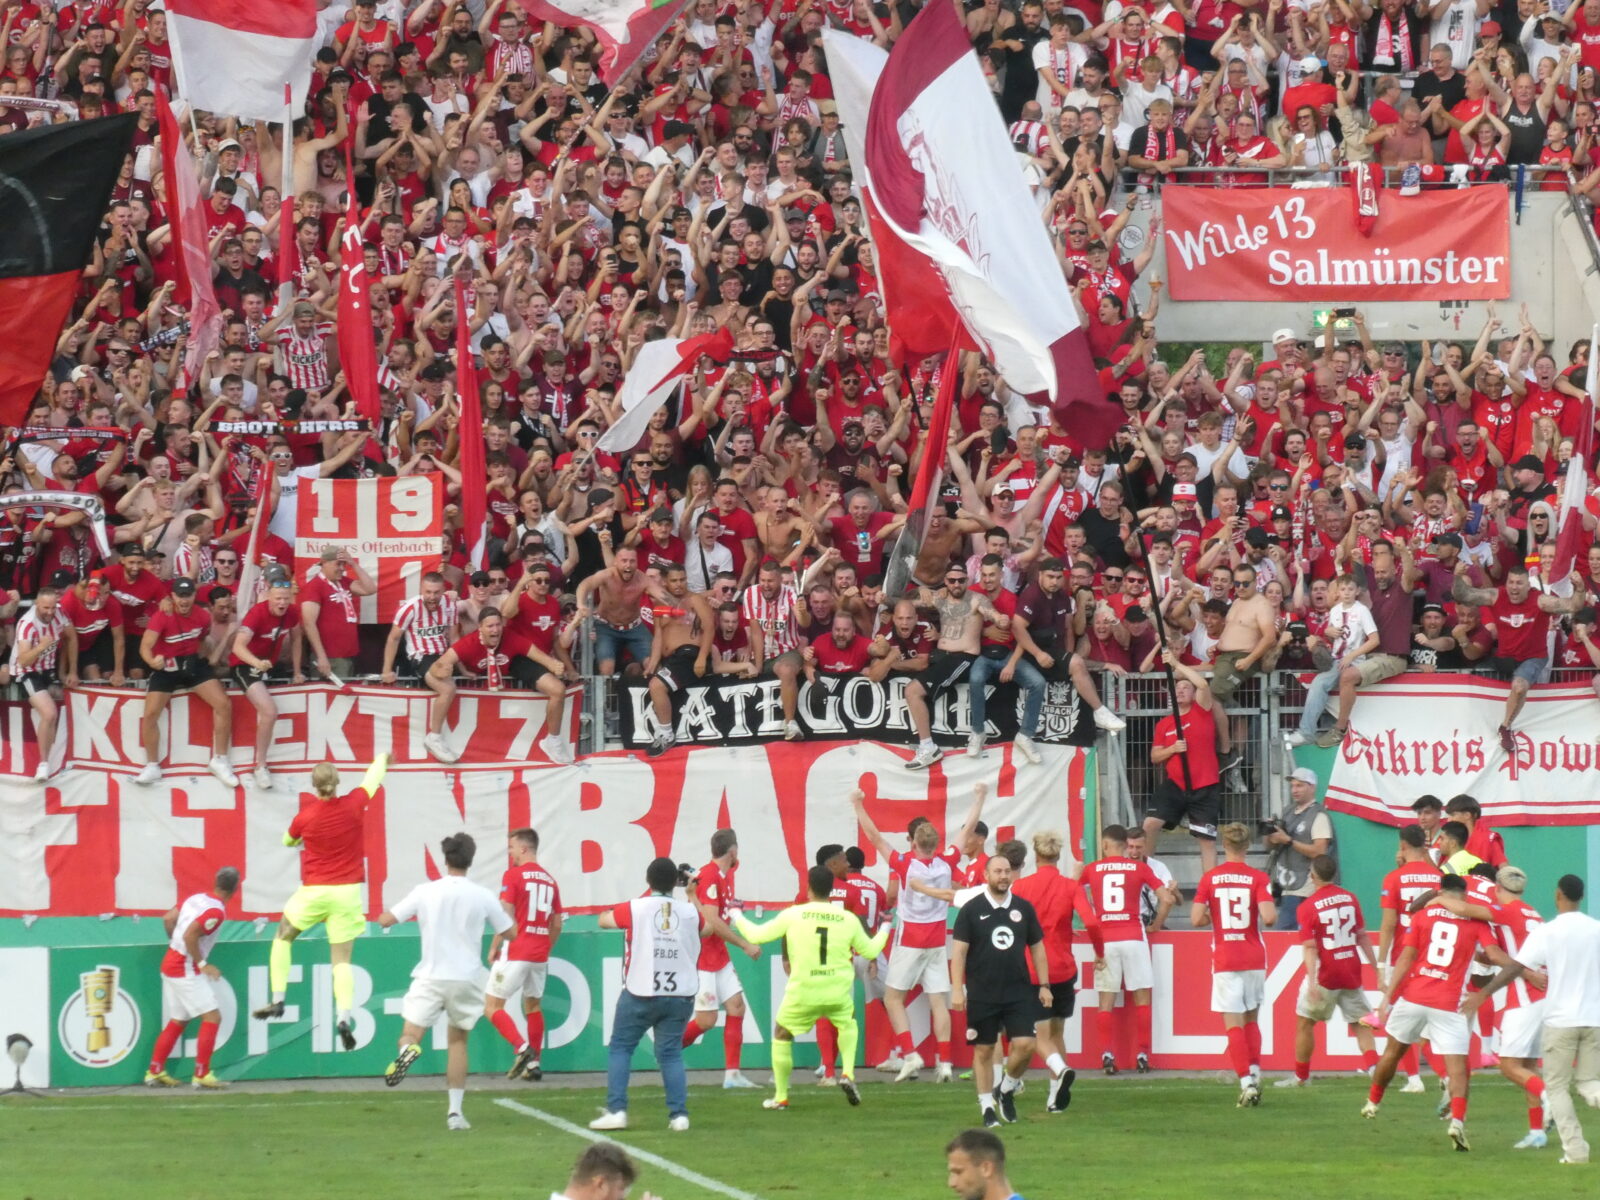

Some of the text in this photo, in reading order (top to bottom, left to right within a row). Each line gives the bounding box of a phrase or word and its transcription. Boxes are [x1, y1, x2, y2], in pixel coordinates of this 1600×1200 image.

[1166, 214, 1269, 271] Wilde
[1268, 197, 1316, 239] 13
[1268, 248, 1504, 286] Salmünster
[306, 540, 433, 554] Kicrs Offenbach
[1498, 730, 1600, 781] Pow
[525, 882, 554, 922] 14
[1102, 873, 1126, 912] 6
[1214, 888, 1251, 930] 13
[801, 910, 845, 923] OFFENBACH
[1318, 905, 1356, 950] 32
[815, 926, 829, 965] 1
[1427, 921, 1458, 967] 8
